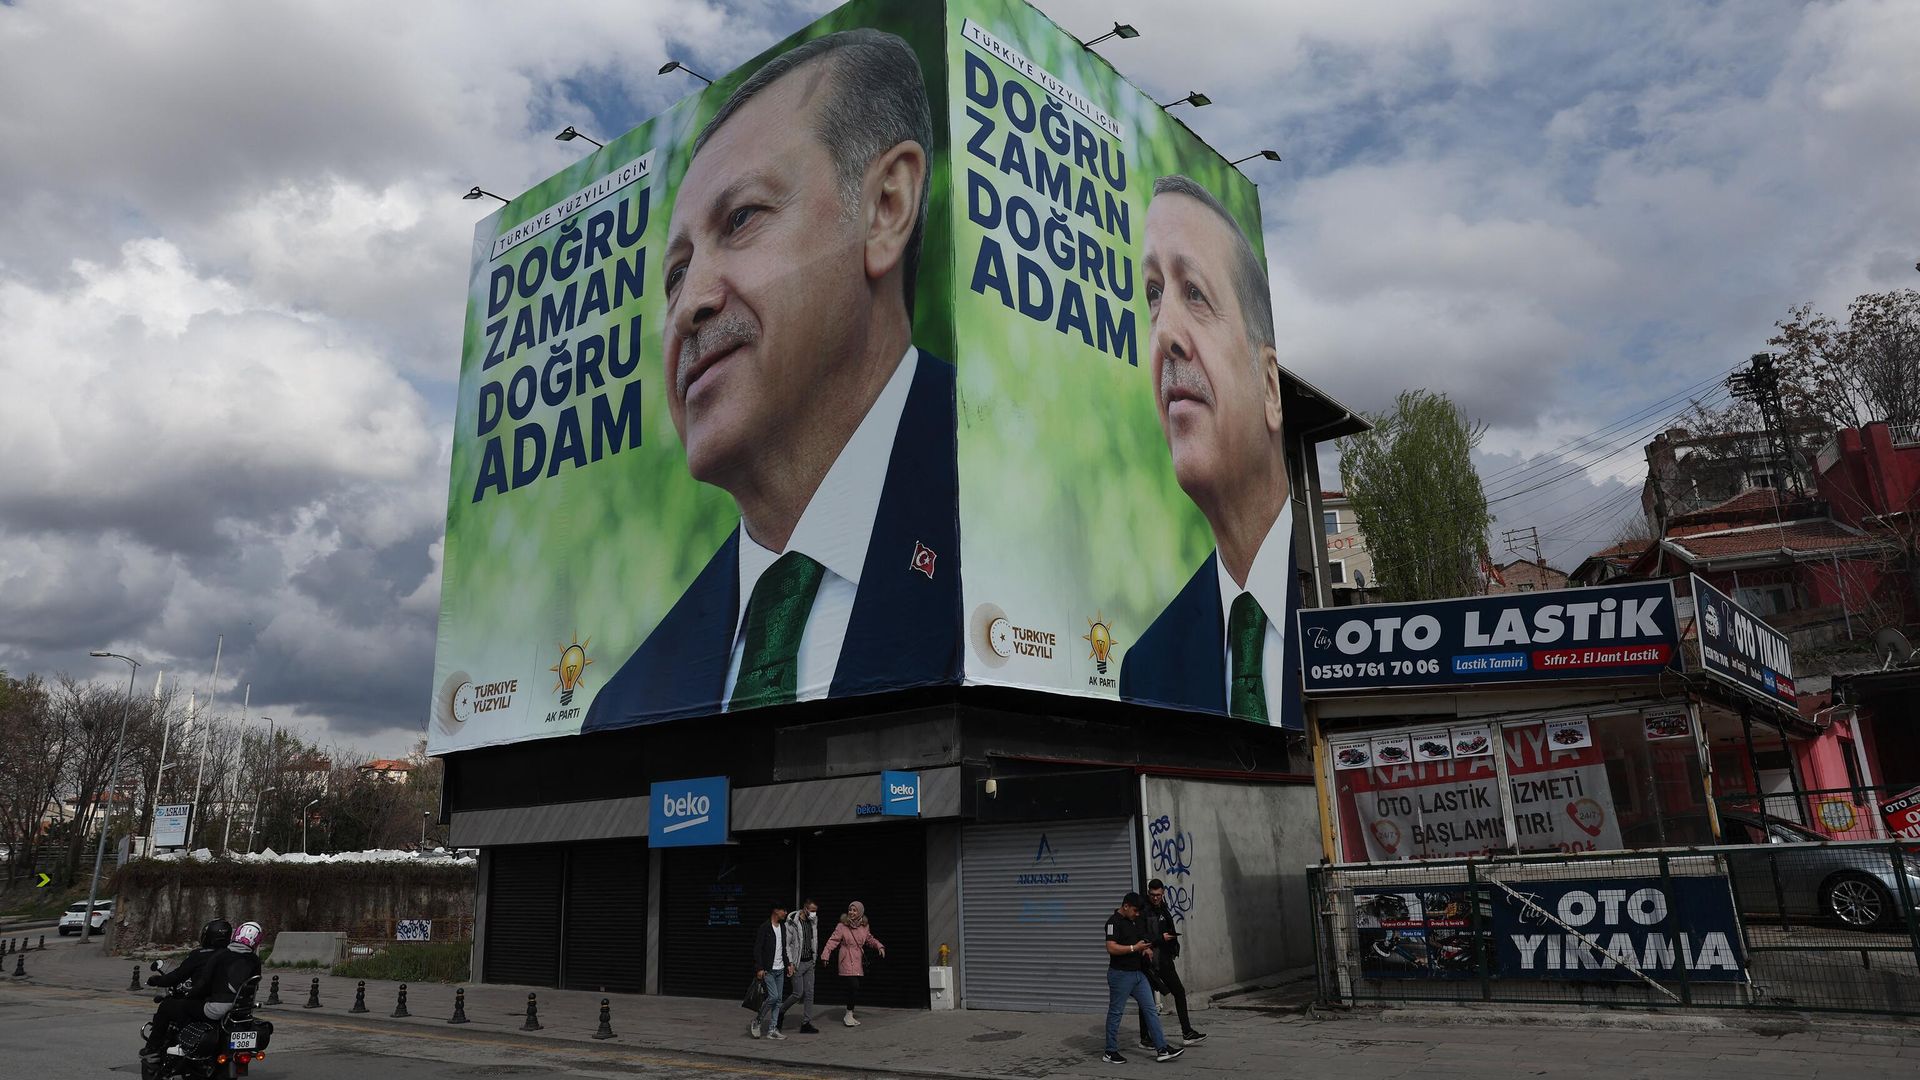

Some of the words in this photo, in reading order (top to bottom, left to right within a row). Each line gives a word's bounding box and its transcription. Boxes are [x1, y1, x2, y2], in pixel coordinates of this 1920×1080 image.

[972, 27, 1033, 77] TÜRKİYE
[1040, 73, 1091, 115] YÜZYILI
[1095, 110, 1120, 134] İÇİN
[965, 49, 1127, 192] DOĞRU
[966, 104, 1131, 245] ZAMAN
[500, 213, 551, 250] TÜRKİYE
[557, 180, 611, 217] YÜZYILI
[617, 159, 648, 185] İÇİN
[487, 186, 650, 319] DOĞRU
[967, 167, 1134, 302] DOĞRU
[482, 246, 647, 371] ZAMAN
[970, 234, 1138, 368] ADAM
[477, 314, 642, 437] DOĞRU
[471, 379, 642, 504] ADAM
[1012, 626, 1056, 646] TÜRKİYE
[1013, 641, 1053, 660] YÜZYILI
[1335, 614, 1442, 655] OTO
[1735, 610, 1756, 660] OTO
[1755, 624, 1793, 681] YIKAMA
[1311, 663, 1354, 680] 0530
[1356, 662, 1385, 677] 761
[1391, 660, 1414, 676] 70
[1416, 658, 1440, 674] 06
[1456, 657, 1487, 670] Lastik
[1489, 656, 1523, 669] Tamiri
[1569, 653, 1581, 664] 2.
[1583, 651, 1594, 664] El
[1595, 651, 1622, 664] Jant
[1623, 649, 1659, 662] Lastik
[474, 679, 518, 699] TÜRKİYE
[1088, 676, 1098, 686] AK
[1099, 677, 1116, 689] PARTİ
[473, 695, 512, 714] YÜZYILI
[544, 711, 556, 723] AK
[558, 707, 581, 721] PARTİ
[663, 791, 710, 817] beko
[890, 783, 914, 795] beko
[1377, 796, 1412, 818] OTO
[1419, 783, 1491, 814] LASTİK
[1511, 769, 1583, 804] İZMETİ
[1885, 799, 1907, 813] OTO
[1557, 887, 1669, 927] OTO
[1510, 931, 1740, 971] YIKAMA
